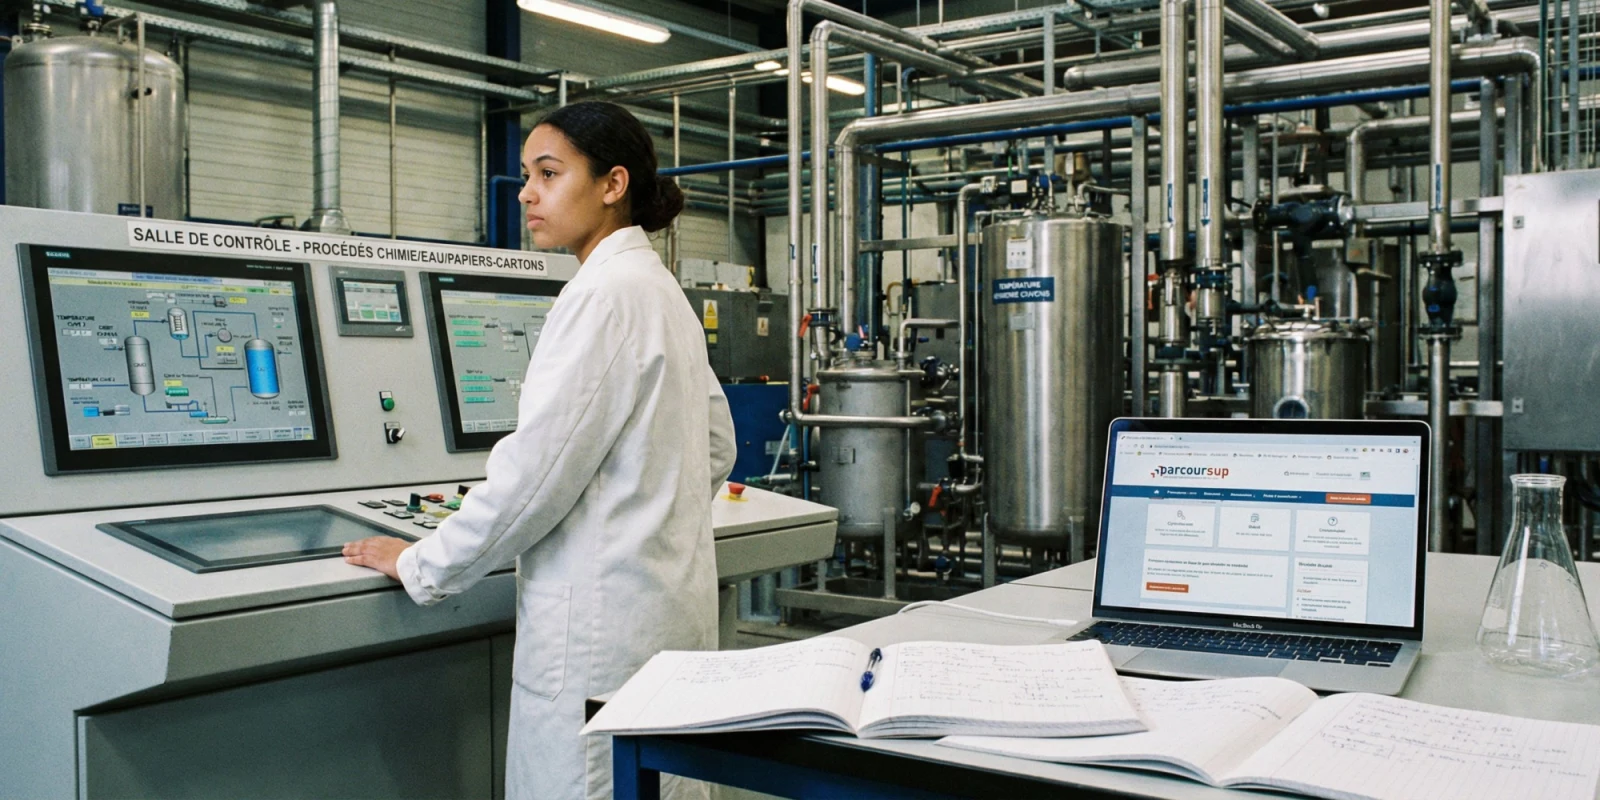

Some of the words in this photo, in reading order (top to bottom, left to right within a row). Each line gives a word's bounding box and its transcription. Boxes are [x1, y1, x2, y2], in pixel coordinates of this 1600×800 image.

[134, 227, 184, 244] SALLE
[189, 232, 209, 246] DE
[213, 234, 292, 252] CONTRÔLE
[303, 240, 374, 258] PROCÉDÉS
[377, 247, 545, 271] CHIMIE/EAU/PAPIERS-CARTONS
[1161, 466, 1229, 479] parcoursup
